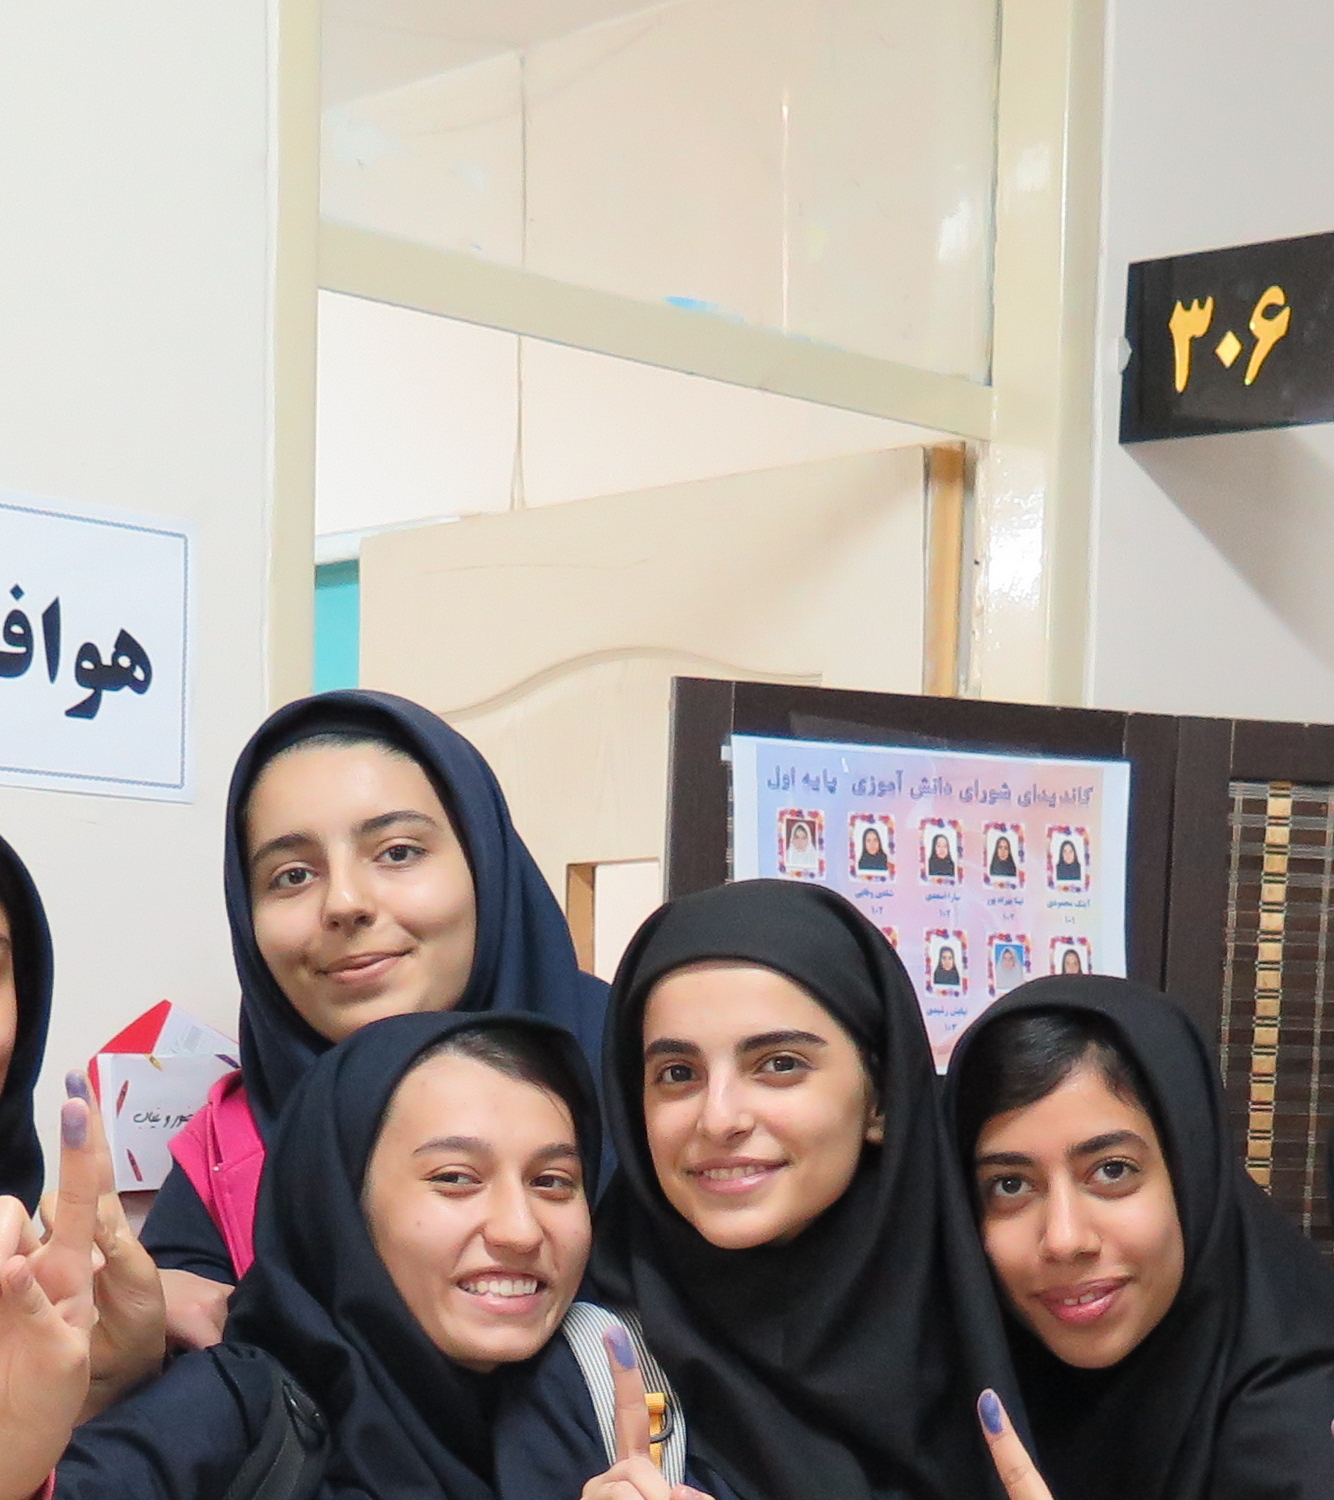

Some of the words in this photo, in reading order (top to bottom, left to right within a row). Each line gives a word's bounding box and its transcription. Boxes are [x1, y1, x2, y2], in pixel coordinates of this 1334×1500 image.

[1168, 285, 1292, 393] ۳۰۶
[767, 765, 796, 791] اول
[801, 768, 838, 795] پایه
[851, 769, 904, 798] آموزی
[910, 776, 953, 800] دانش
[959, 779, 1011, 805] شورای
